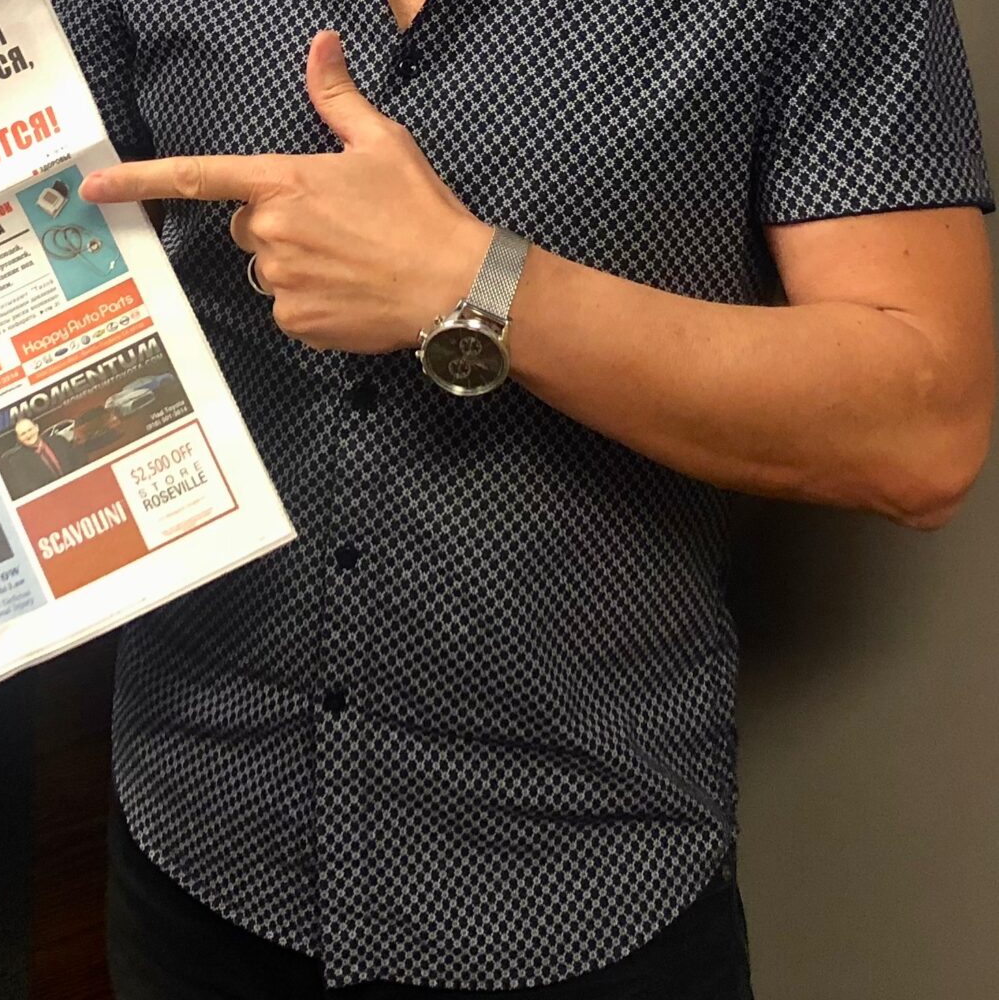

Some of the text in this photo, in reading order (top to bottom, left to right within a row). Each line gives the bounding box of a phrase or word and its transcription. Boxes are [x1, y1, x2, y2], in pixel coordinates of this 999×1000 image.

[20, 323, 70, 358] Happy
[65, 307, 102, 335] Auto
[97, 291, 135, 319] Parts
[4, 336, 161, 426] MOMENTUM
[61, 352, 164, 407] MOMENTUMTOYOTA.COM
[149, 398, 186, 421] Vlad Toyota
[128, 441, 195, 486] $2,500 OFF
[136, 459, 203, 499] STORE
[141, 469, 209, 512] ROSEVILLE
[35, 499, 129, 561] SCAVOLINI
